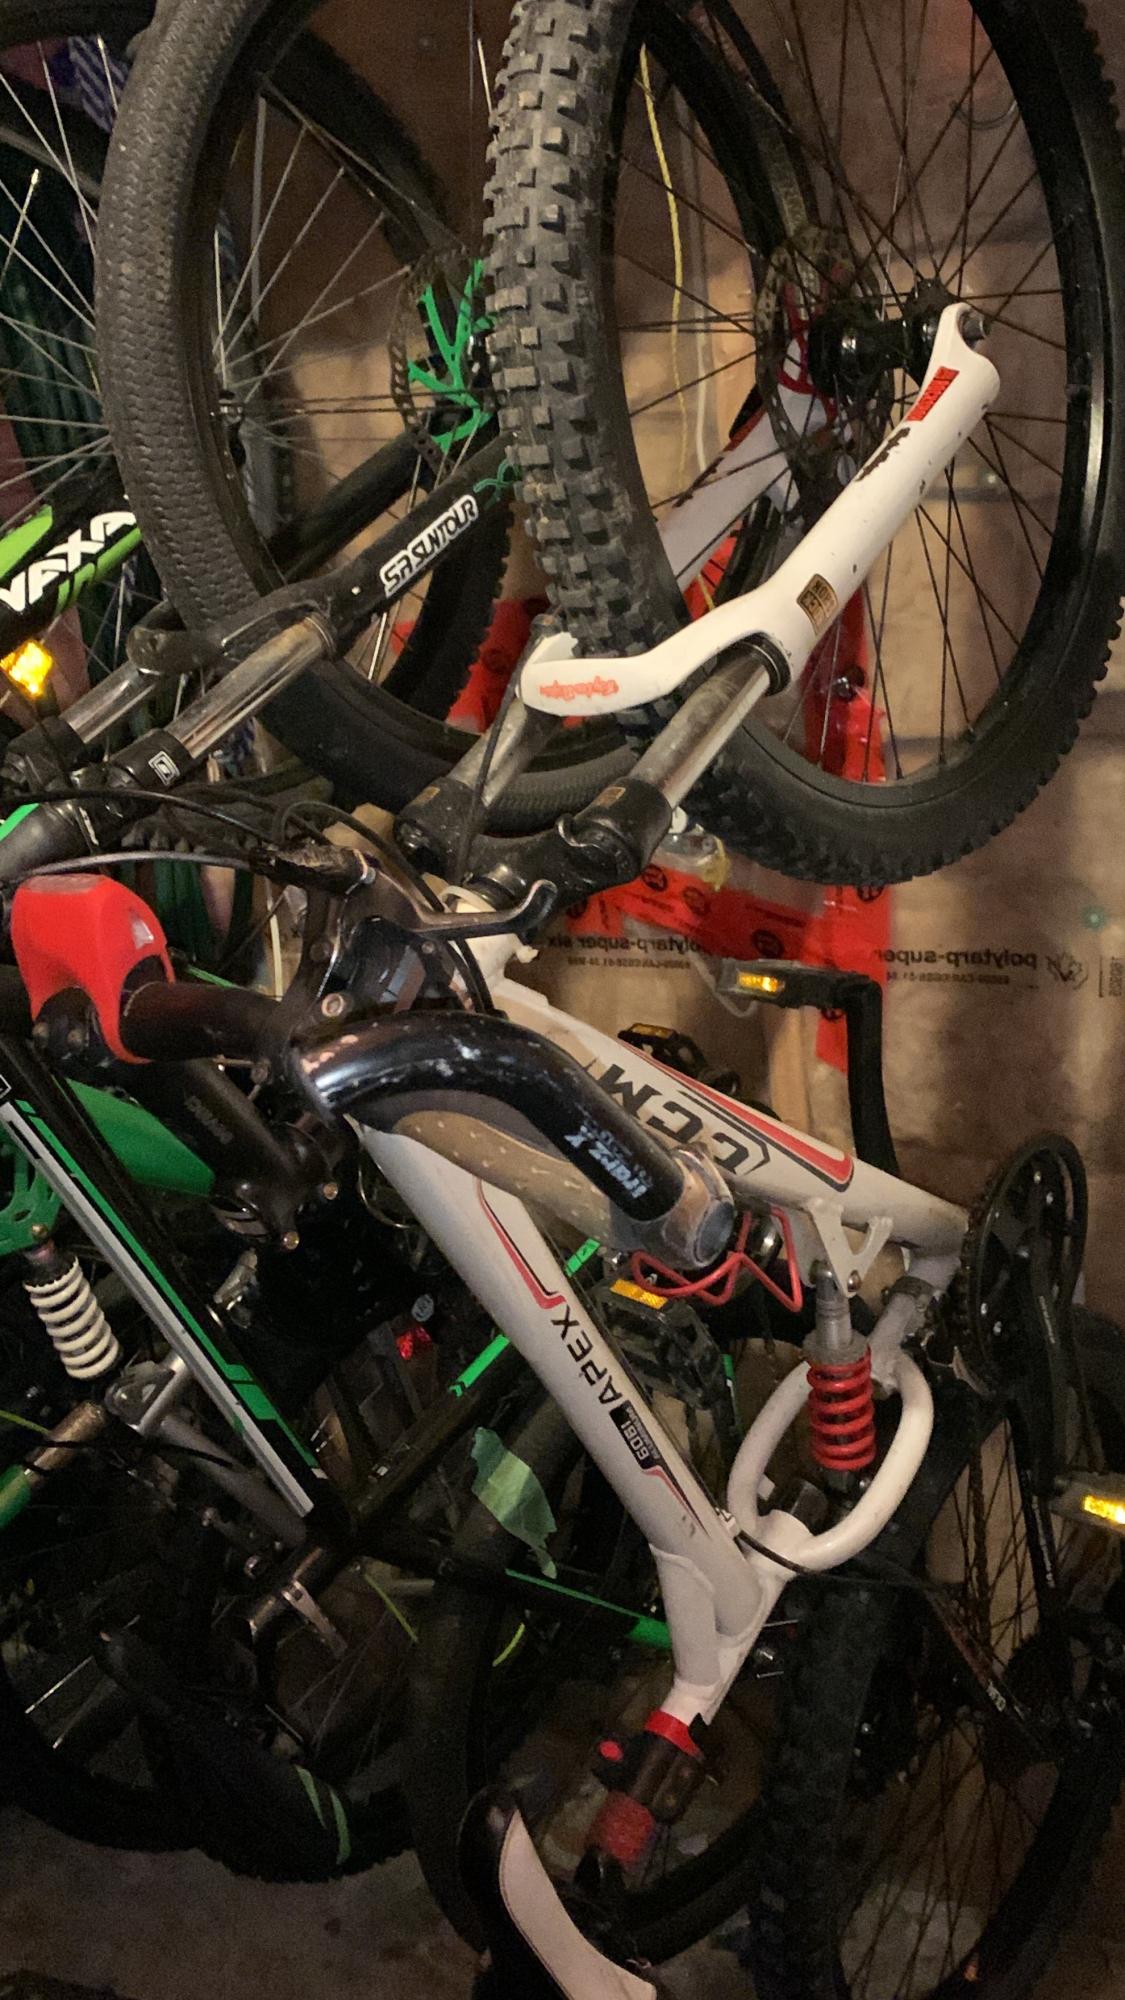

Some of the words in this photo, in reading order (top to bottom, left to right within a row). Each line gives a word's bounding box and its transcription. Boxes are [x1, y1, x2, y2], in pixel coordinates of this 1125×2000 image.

[384, 555, 413, 592] SR
[412, 499, 476, 568] SUNTOUR
[594, 1063, 750, 1176] CCM
[551, 1304, 623, 1404] APEX
[620, 1420, 650, 1461] 6061
